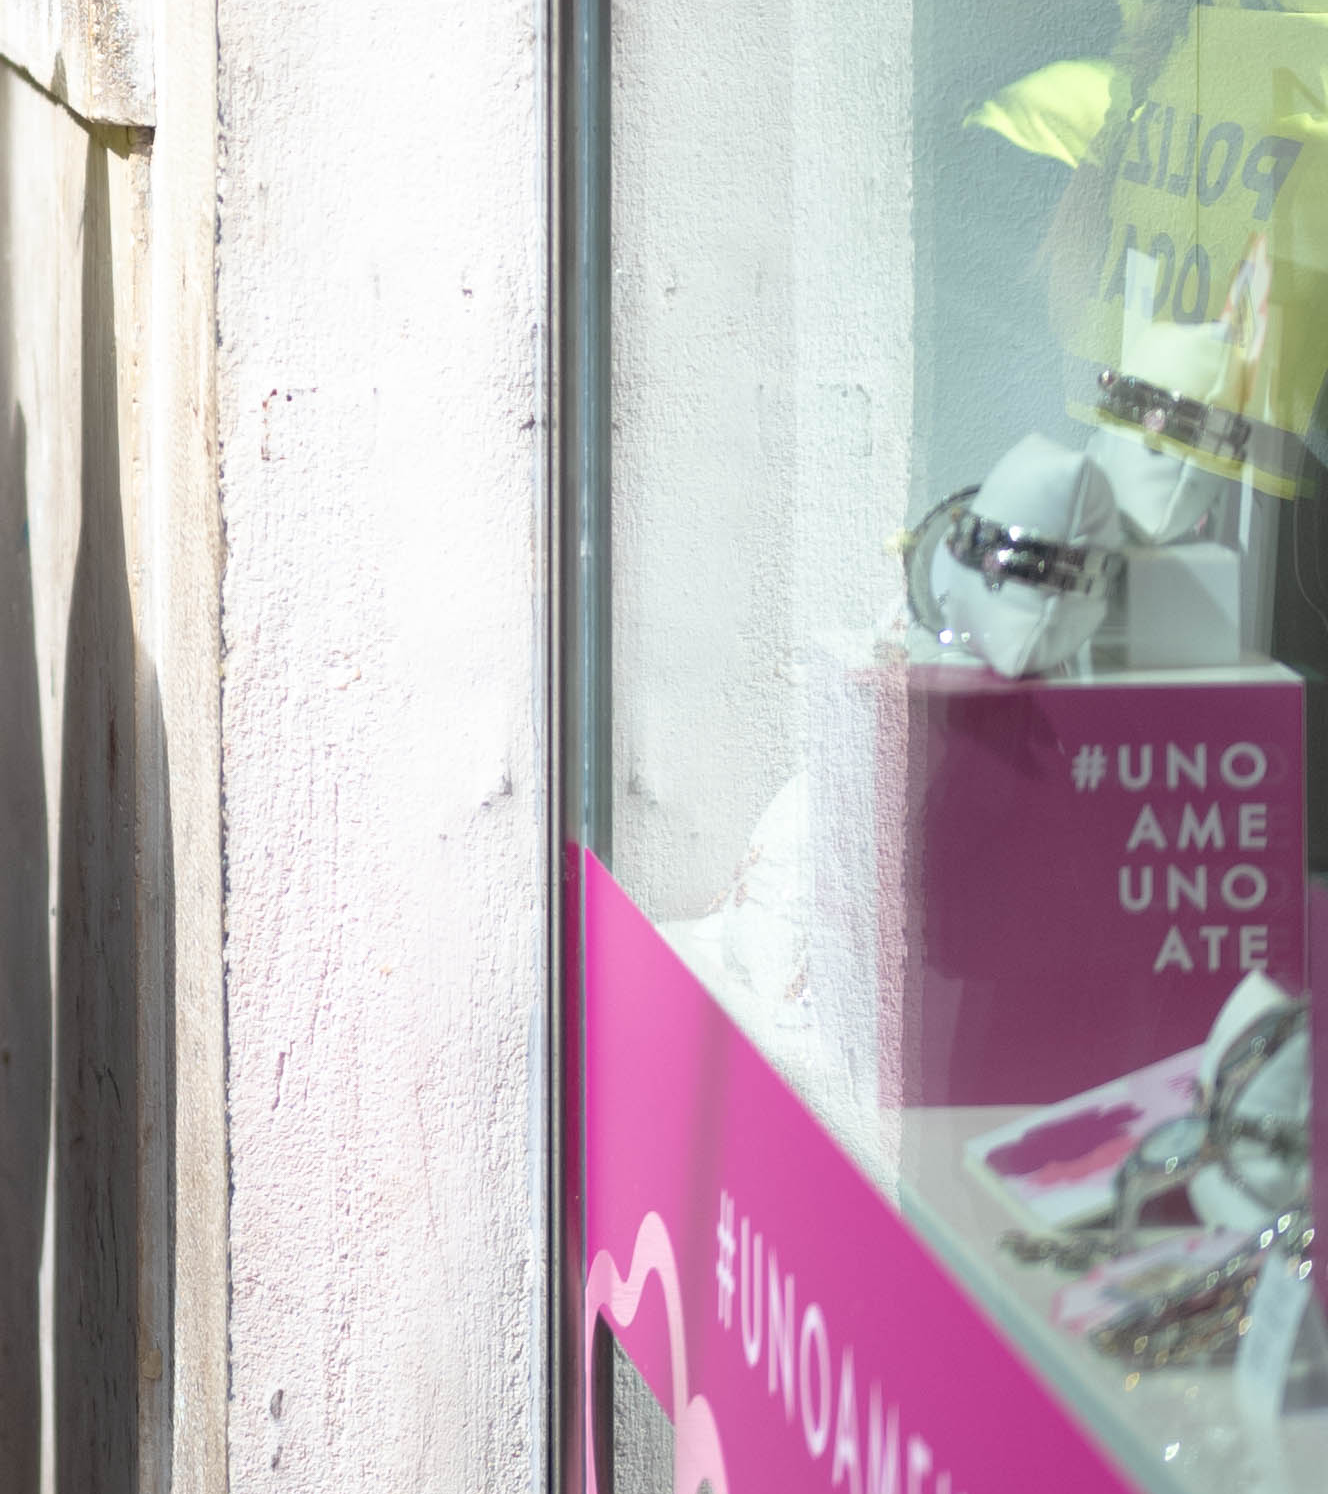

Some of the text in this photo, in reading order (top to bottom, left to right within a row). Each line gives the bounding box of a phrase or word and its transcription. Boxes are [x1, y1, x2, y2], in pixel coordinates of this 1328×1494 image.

[1072, 742, 1267, 791] #UNO
[1127, 802, 1267, 851] AME
[1119, 863, 1268, 912] UNO
[1154, 925, 1268, 972] ATE
